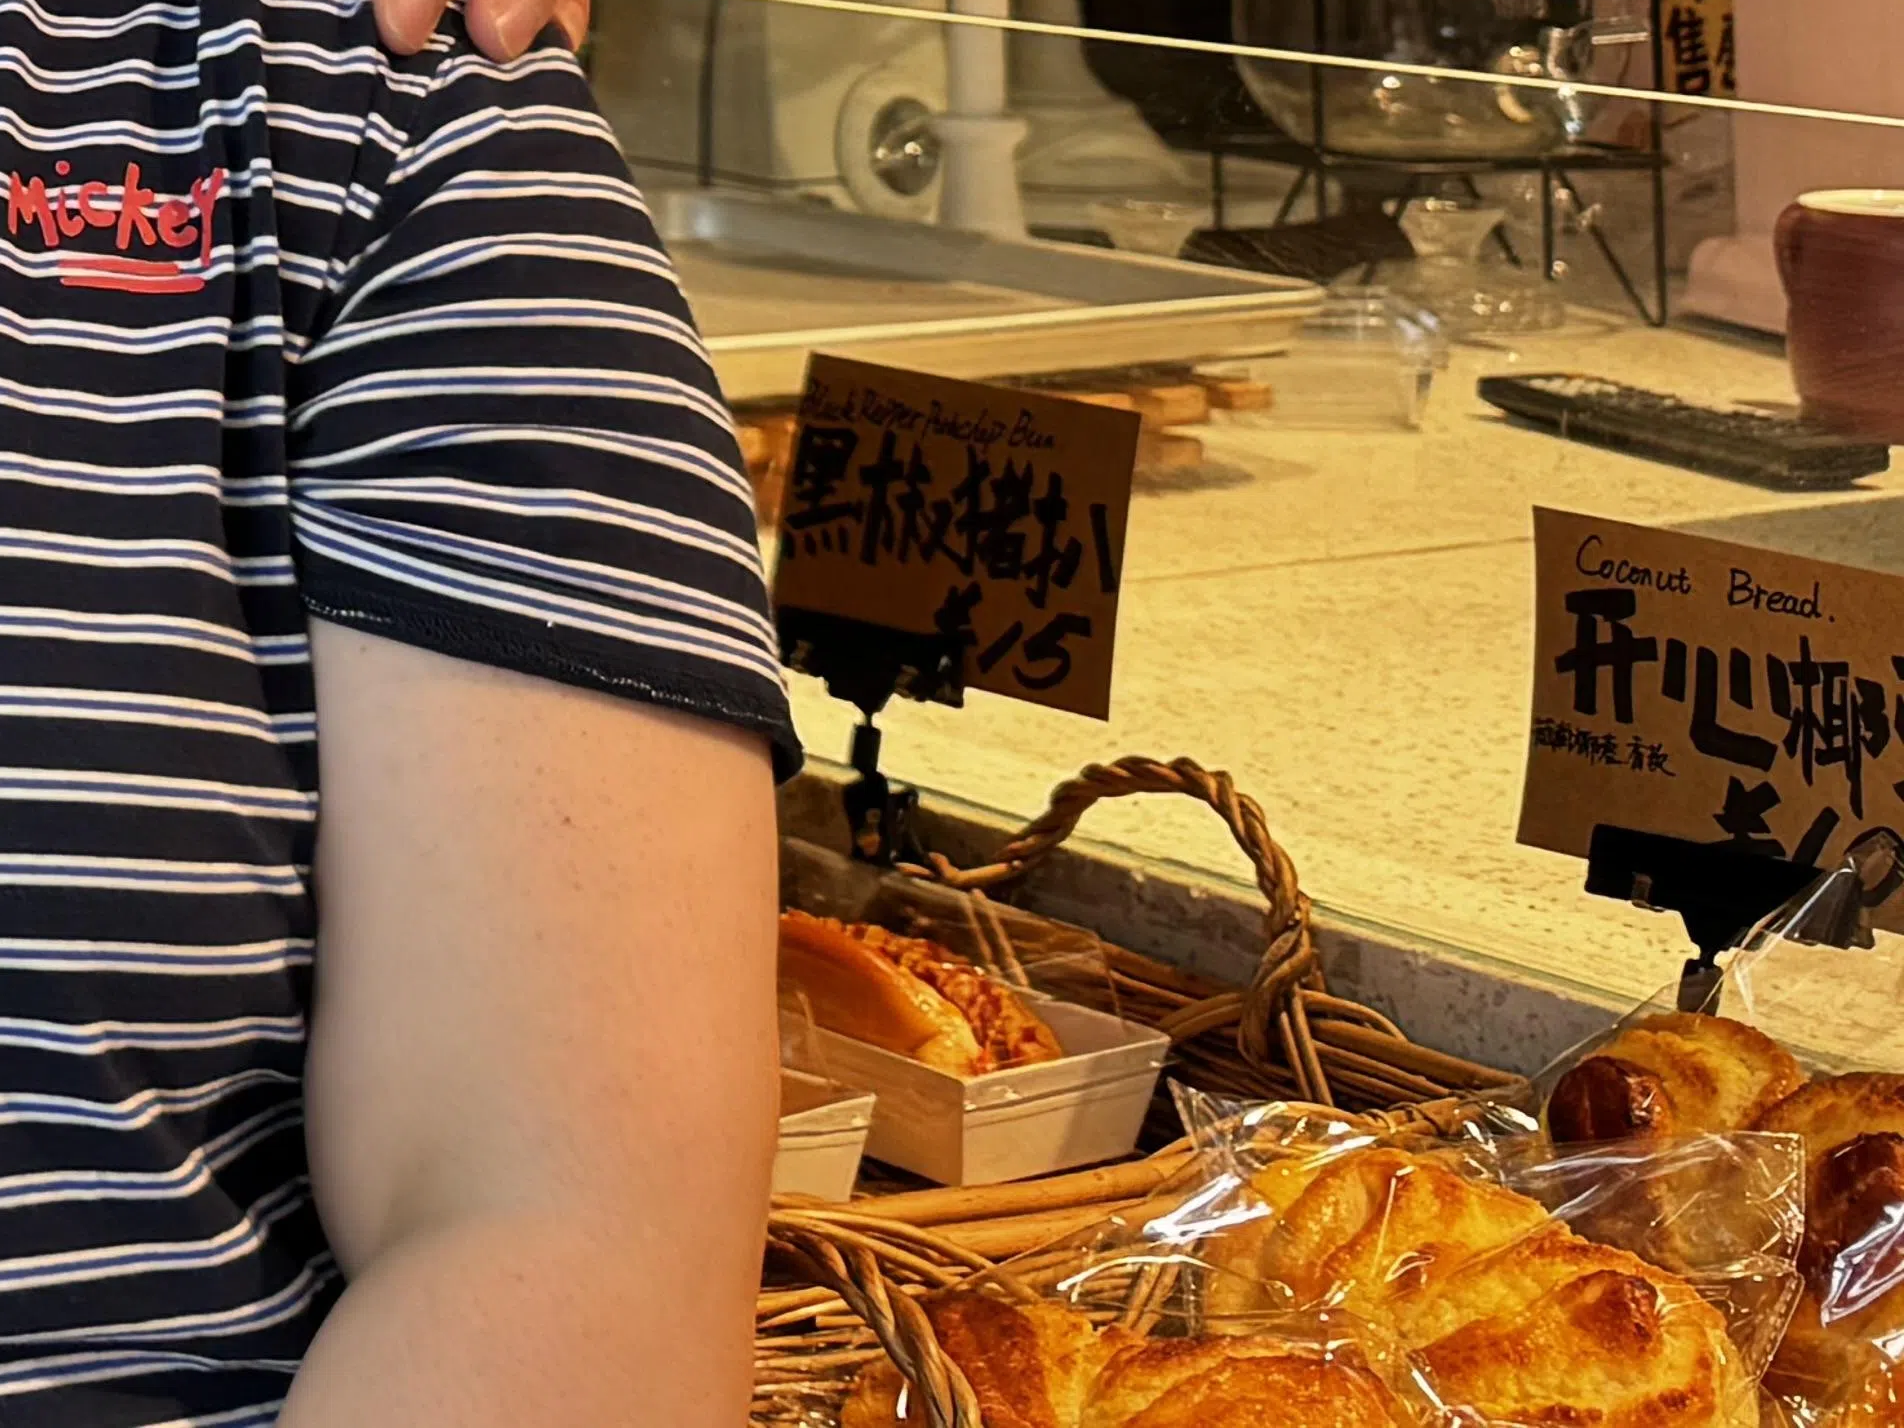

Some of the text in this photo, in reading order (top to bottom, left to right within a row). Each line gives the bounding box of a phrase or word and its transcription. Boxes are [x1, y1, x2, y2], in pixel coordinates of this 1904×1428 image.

[1575, 534, 1692, 595] Coconut
[1553, 587, 1904, 821] 开心椰
